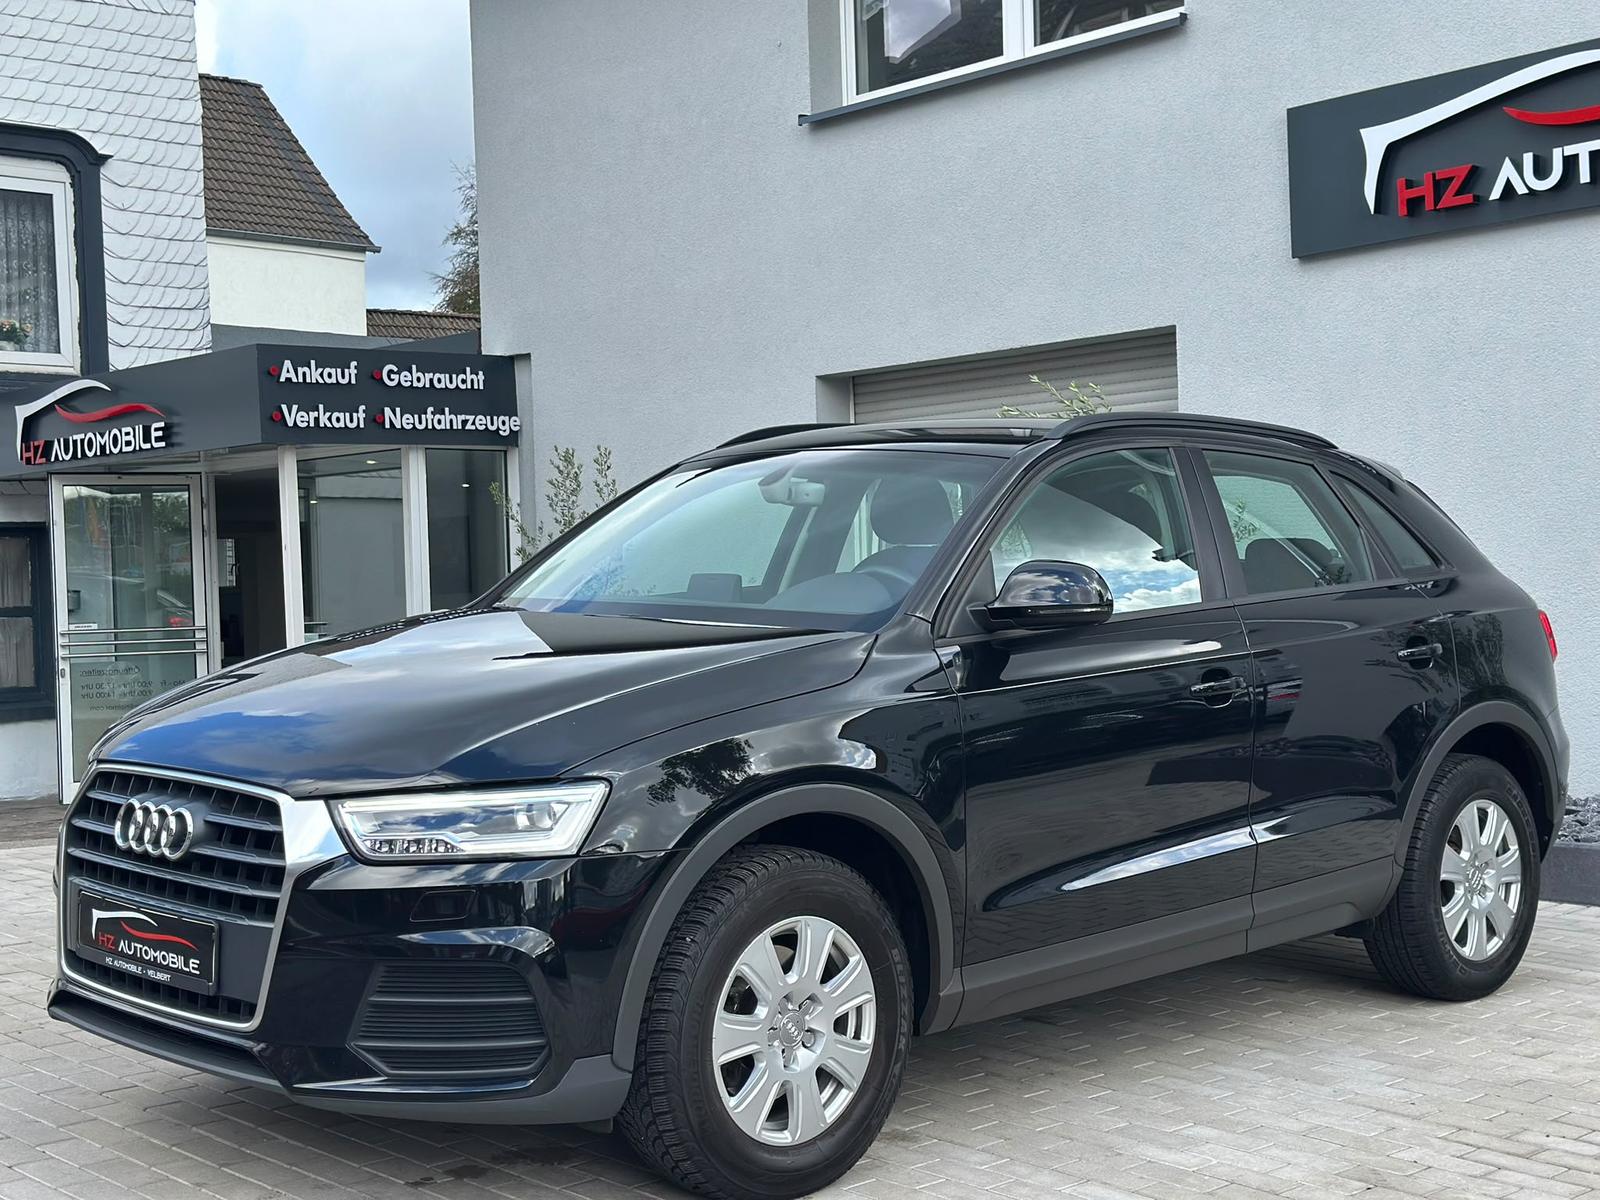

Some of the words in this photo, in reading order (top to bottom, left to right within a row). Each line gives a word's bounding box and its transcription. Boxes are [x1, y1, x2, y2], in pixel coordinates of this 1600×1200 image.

[1396, 164, 1475, 217] HZ
[279, 359, 358, 385] Ankauf
[381, 364, 485, 391] Gebraucht
[281, 404, 366, 430] Verkauf
[384, 406, 521, 436] Neufahrzeuge
[21, 439, 46, 466] HZ
[50, 421, 166, 463] AUTOMOBILE
[98, 931, 116, 950] HZ
[118, 940, 200, 974] AUTOMOBILE
[105, 956, 113, 965] HZ
[113, 960, 142, 974] AUTOMOBILE
[147, 969, 172, 982] VELBERT
